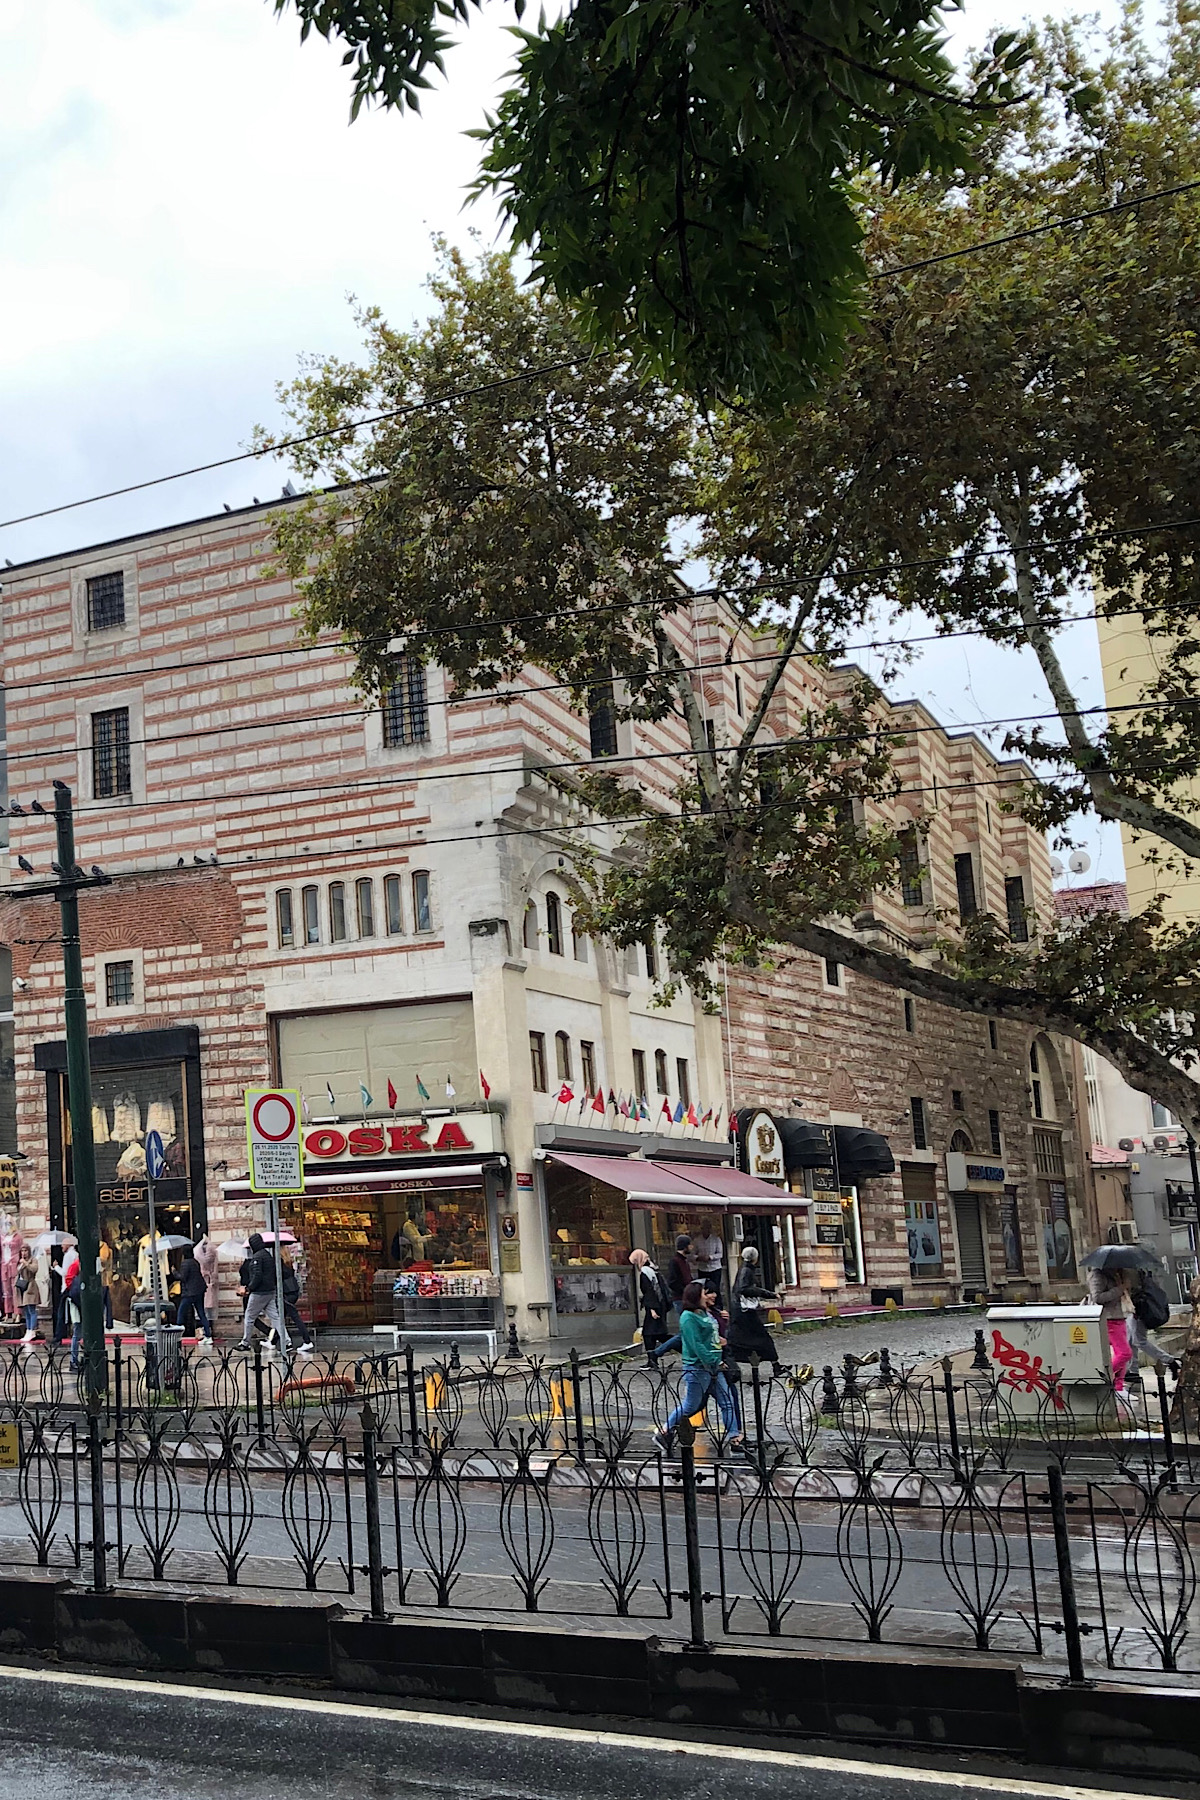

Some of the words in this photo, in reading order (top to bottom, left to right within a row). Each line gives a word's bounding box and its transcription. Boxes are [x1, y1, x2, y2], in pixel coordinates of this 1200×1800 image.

[302, 1121, 475, 1159] OSKA
[327, 1184, 369, 1193] KOSKA
[390, 1180, 434, 1190] KOSKA
